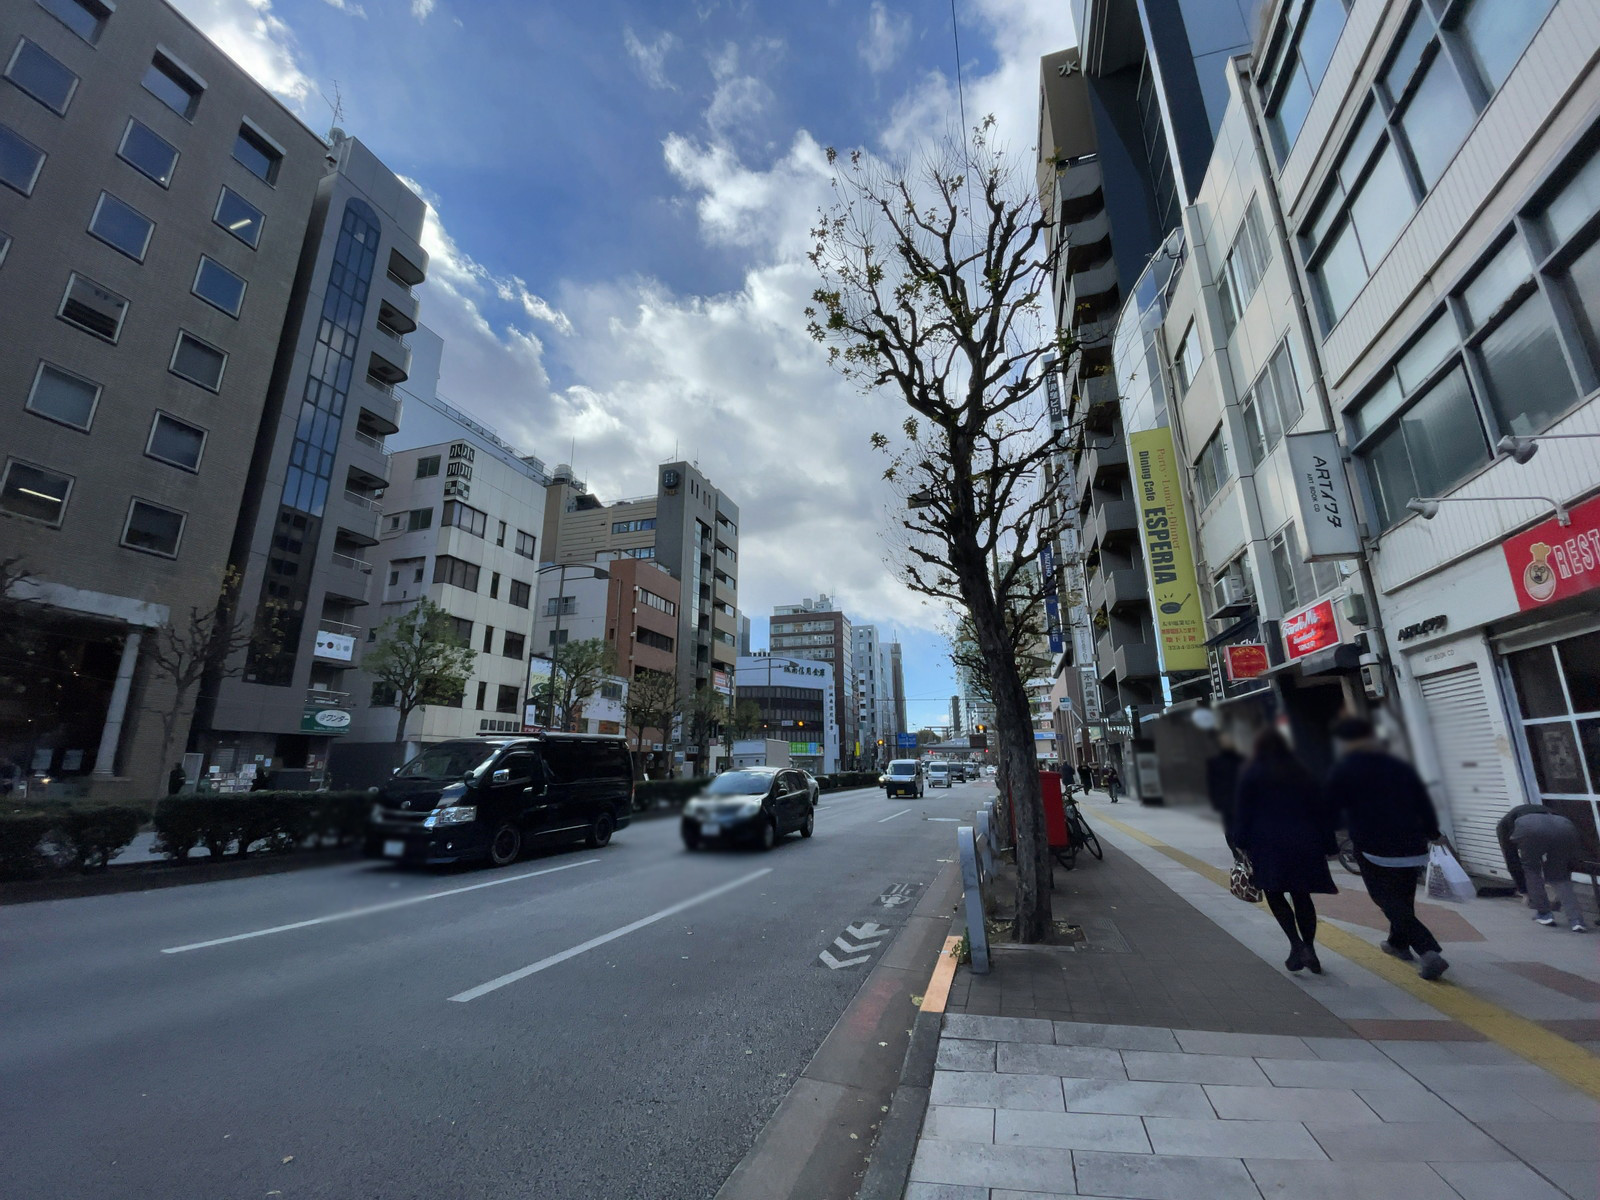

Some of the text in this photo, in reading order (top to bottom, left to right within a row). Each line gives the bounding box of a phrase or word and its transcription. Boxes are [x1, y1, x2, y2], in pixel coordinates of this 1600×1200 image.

[1058, 60, 1079, 76] 水
[1309, 485, 1319, 503] BOOK
[1313, 503, 1321, 513] CD
[1138, 450, 1178, 585] Dining Cafe ESPERIA
